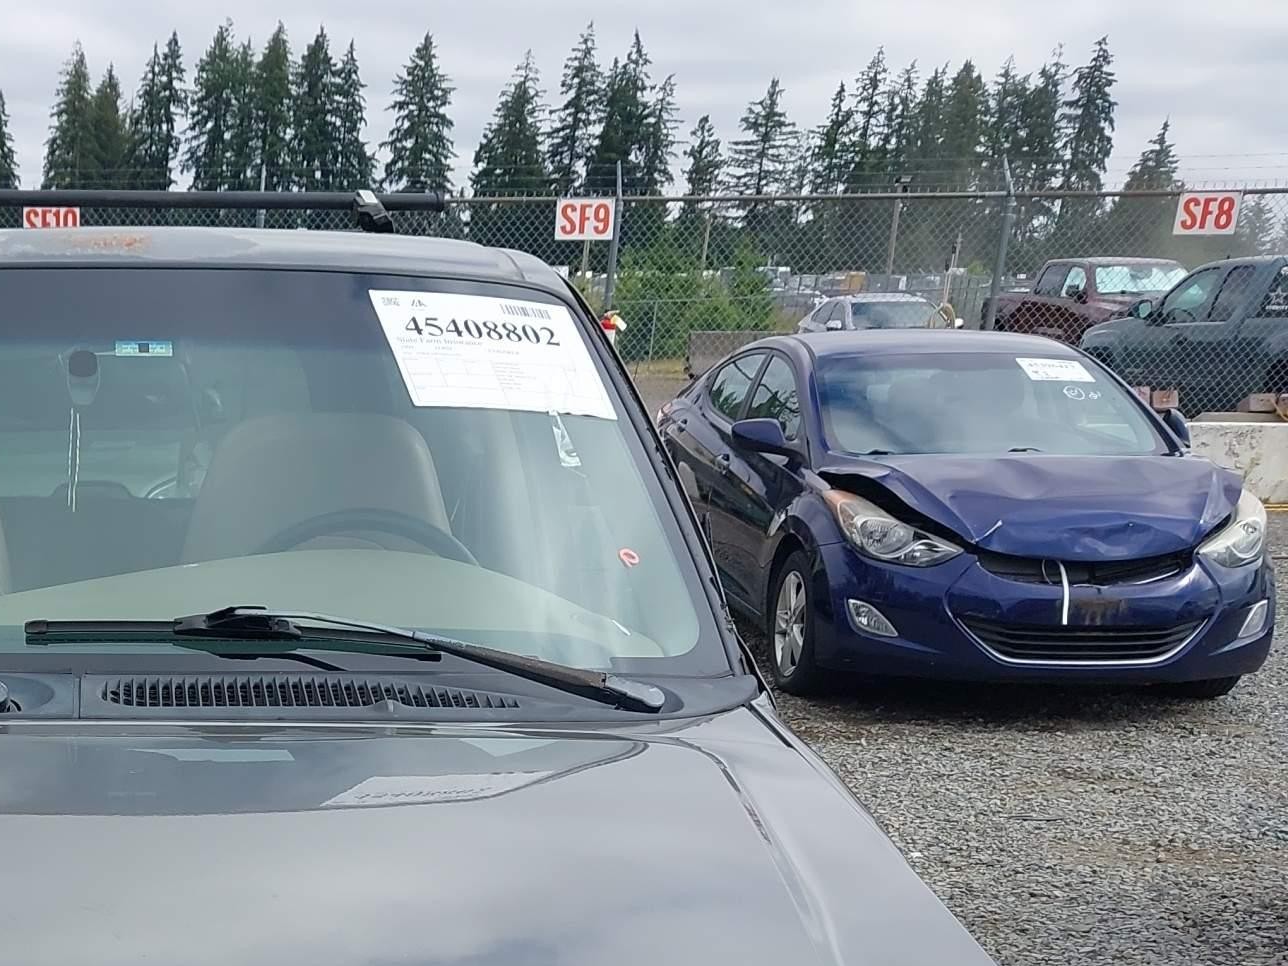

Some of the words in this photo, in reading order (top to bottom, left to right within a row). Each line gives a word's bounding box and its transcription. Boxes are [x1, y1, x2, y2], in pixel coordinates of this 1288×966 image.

[560, 203, 610, 235] SF9
[1180, 196, 1236, 230] SF8
[405, 316, 561, 347] 45408802
